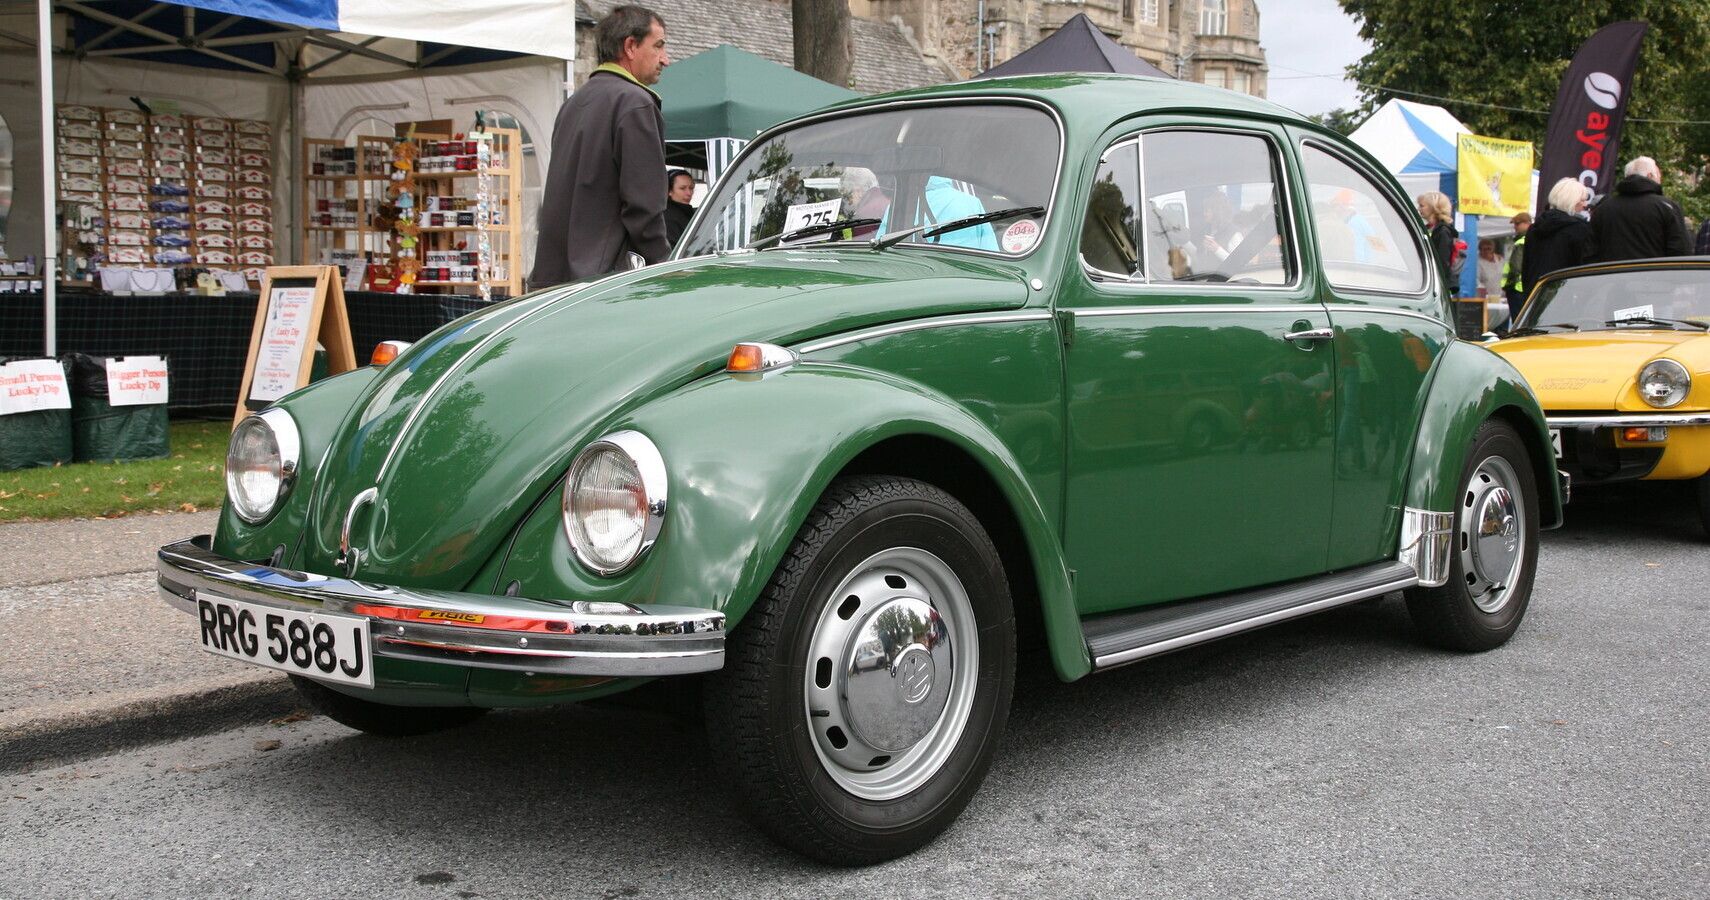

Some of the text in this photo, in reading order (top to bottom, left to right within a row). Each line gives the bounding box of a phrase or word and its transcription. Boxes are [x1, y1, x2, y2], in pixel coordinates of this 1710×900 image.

[802, 210, 832, 227] 275
[0, 374, 26, 385] Small
[119, 380, 161, 391] Lucky Dip
[8, 384, 59, 396] Lucky Dip
[198, 599, 259, 657] RRG
